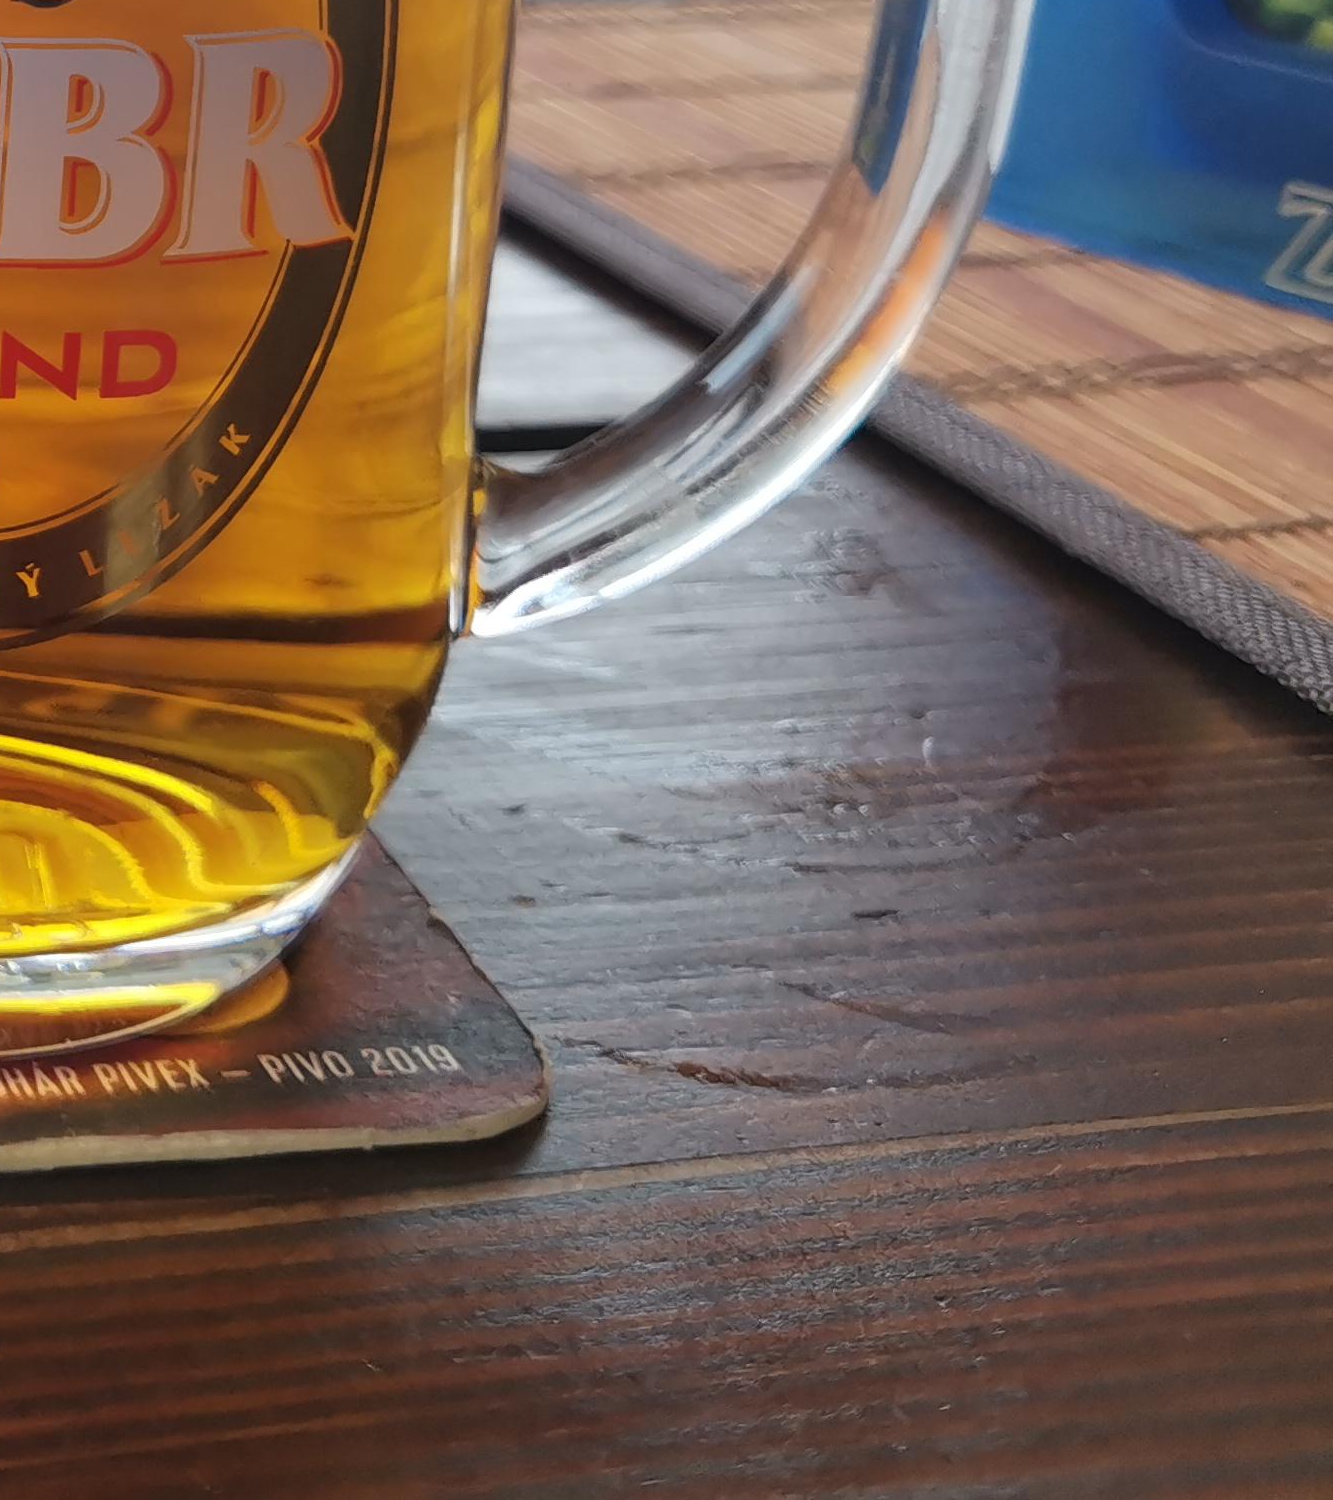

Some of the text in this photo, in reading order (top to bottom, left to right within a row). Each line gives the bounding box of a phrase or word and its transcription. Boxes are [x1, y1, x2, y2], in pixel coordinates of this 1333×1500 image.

[92, 1056, 210, 1097] PIVEX
[258, 1051, 351, 1085] PIVO
[360, 1043, 462, 1077] 2019
